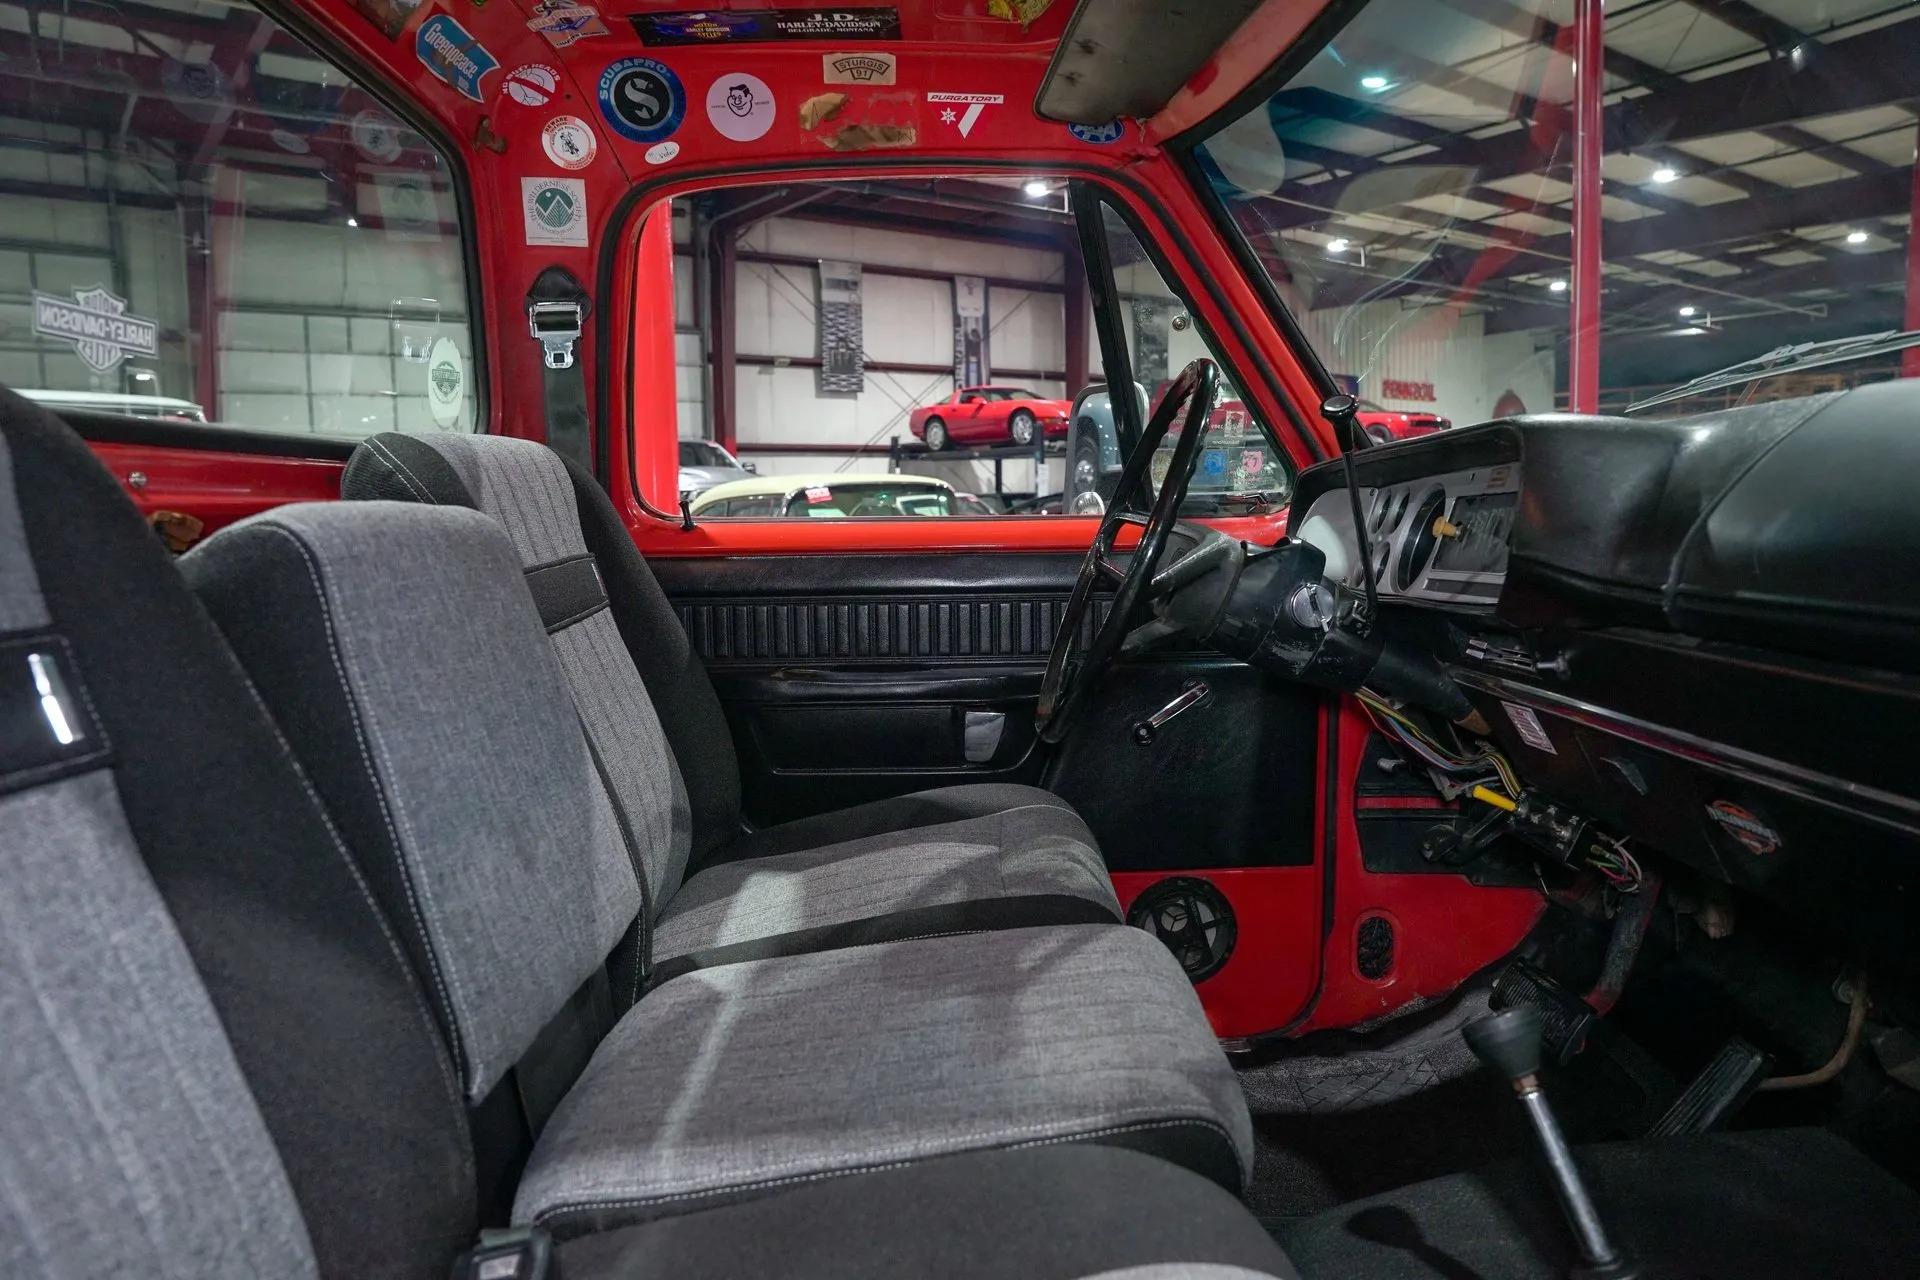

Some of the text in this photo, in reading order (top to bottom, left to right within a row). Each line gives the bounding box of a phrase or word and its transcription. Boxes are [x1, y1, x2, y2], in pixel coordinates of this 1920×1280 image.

[807, 13, 860, 22] J.D.
[777, 21, 881, 29] HARLEY-DAVIDSON
[424, 22, 479, 79] Greenpeace
[839, 59, 884, 71] STURGIS
[599, 58, 668, 100] SCUBAPRO
[856, 69, 868, 78] 91
[930, 94, 1000, 102] PURGATORY
[544, 116, 568, 133] BEWARE
[528, 180, 571, 204] WILDERNESS
